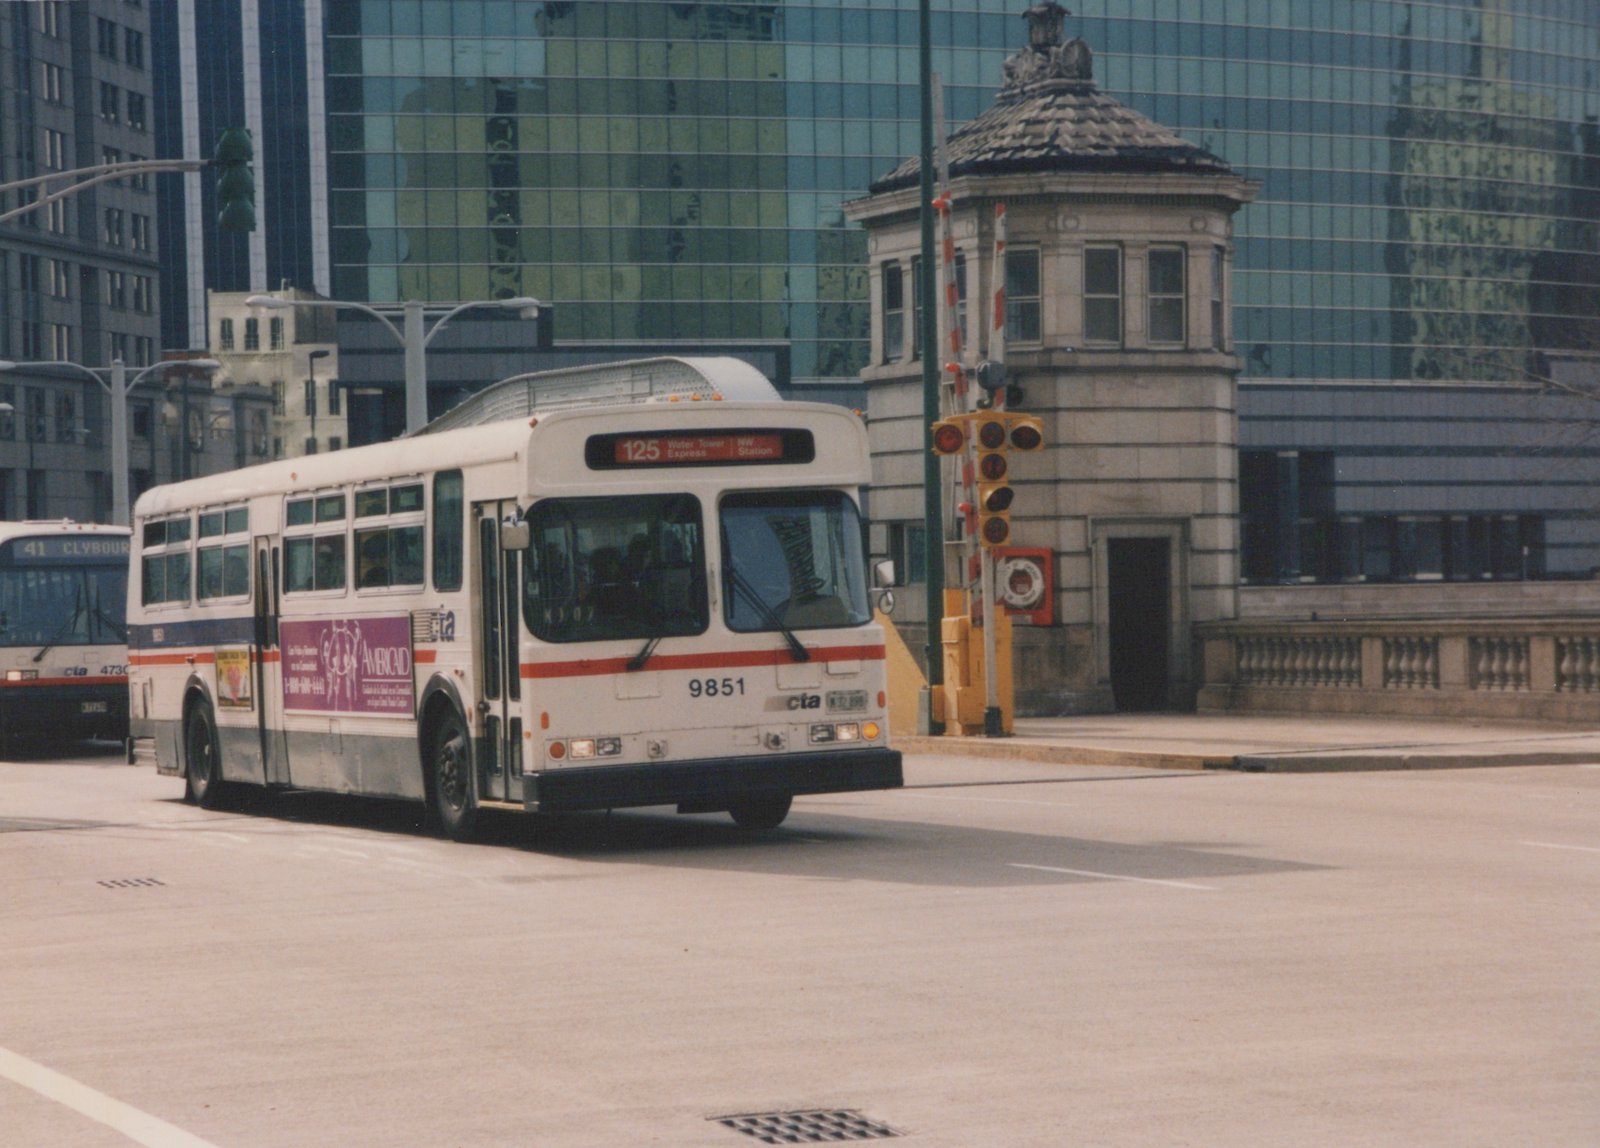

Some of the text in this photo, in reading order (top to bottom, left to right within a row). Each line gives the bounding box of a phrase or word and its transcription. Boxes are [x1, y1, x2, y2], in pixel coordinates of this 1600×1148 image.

[623, 440, 660, 461] 125
[667, 439, 694, 450] Water
[699, 438, 725, 448] Tower
[667, 446, 773, 459] Express Station
[25, 541, 45, 556] 41
[65, 666, 87, 676] cta
[688, 677, 745, 698] 9851
[786, 692, 821, 711] cta
